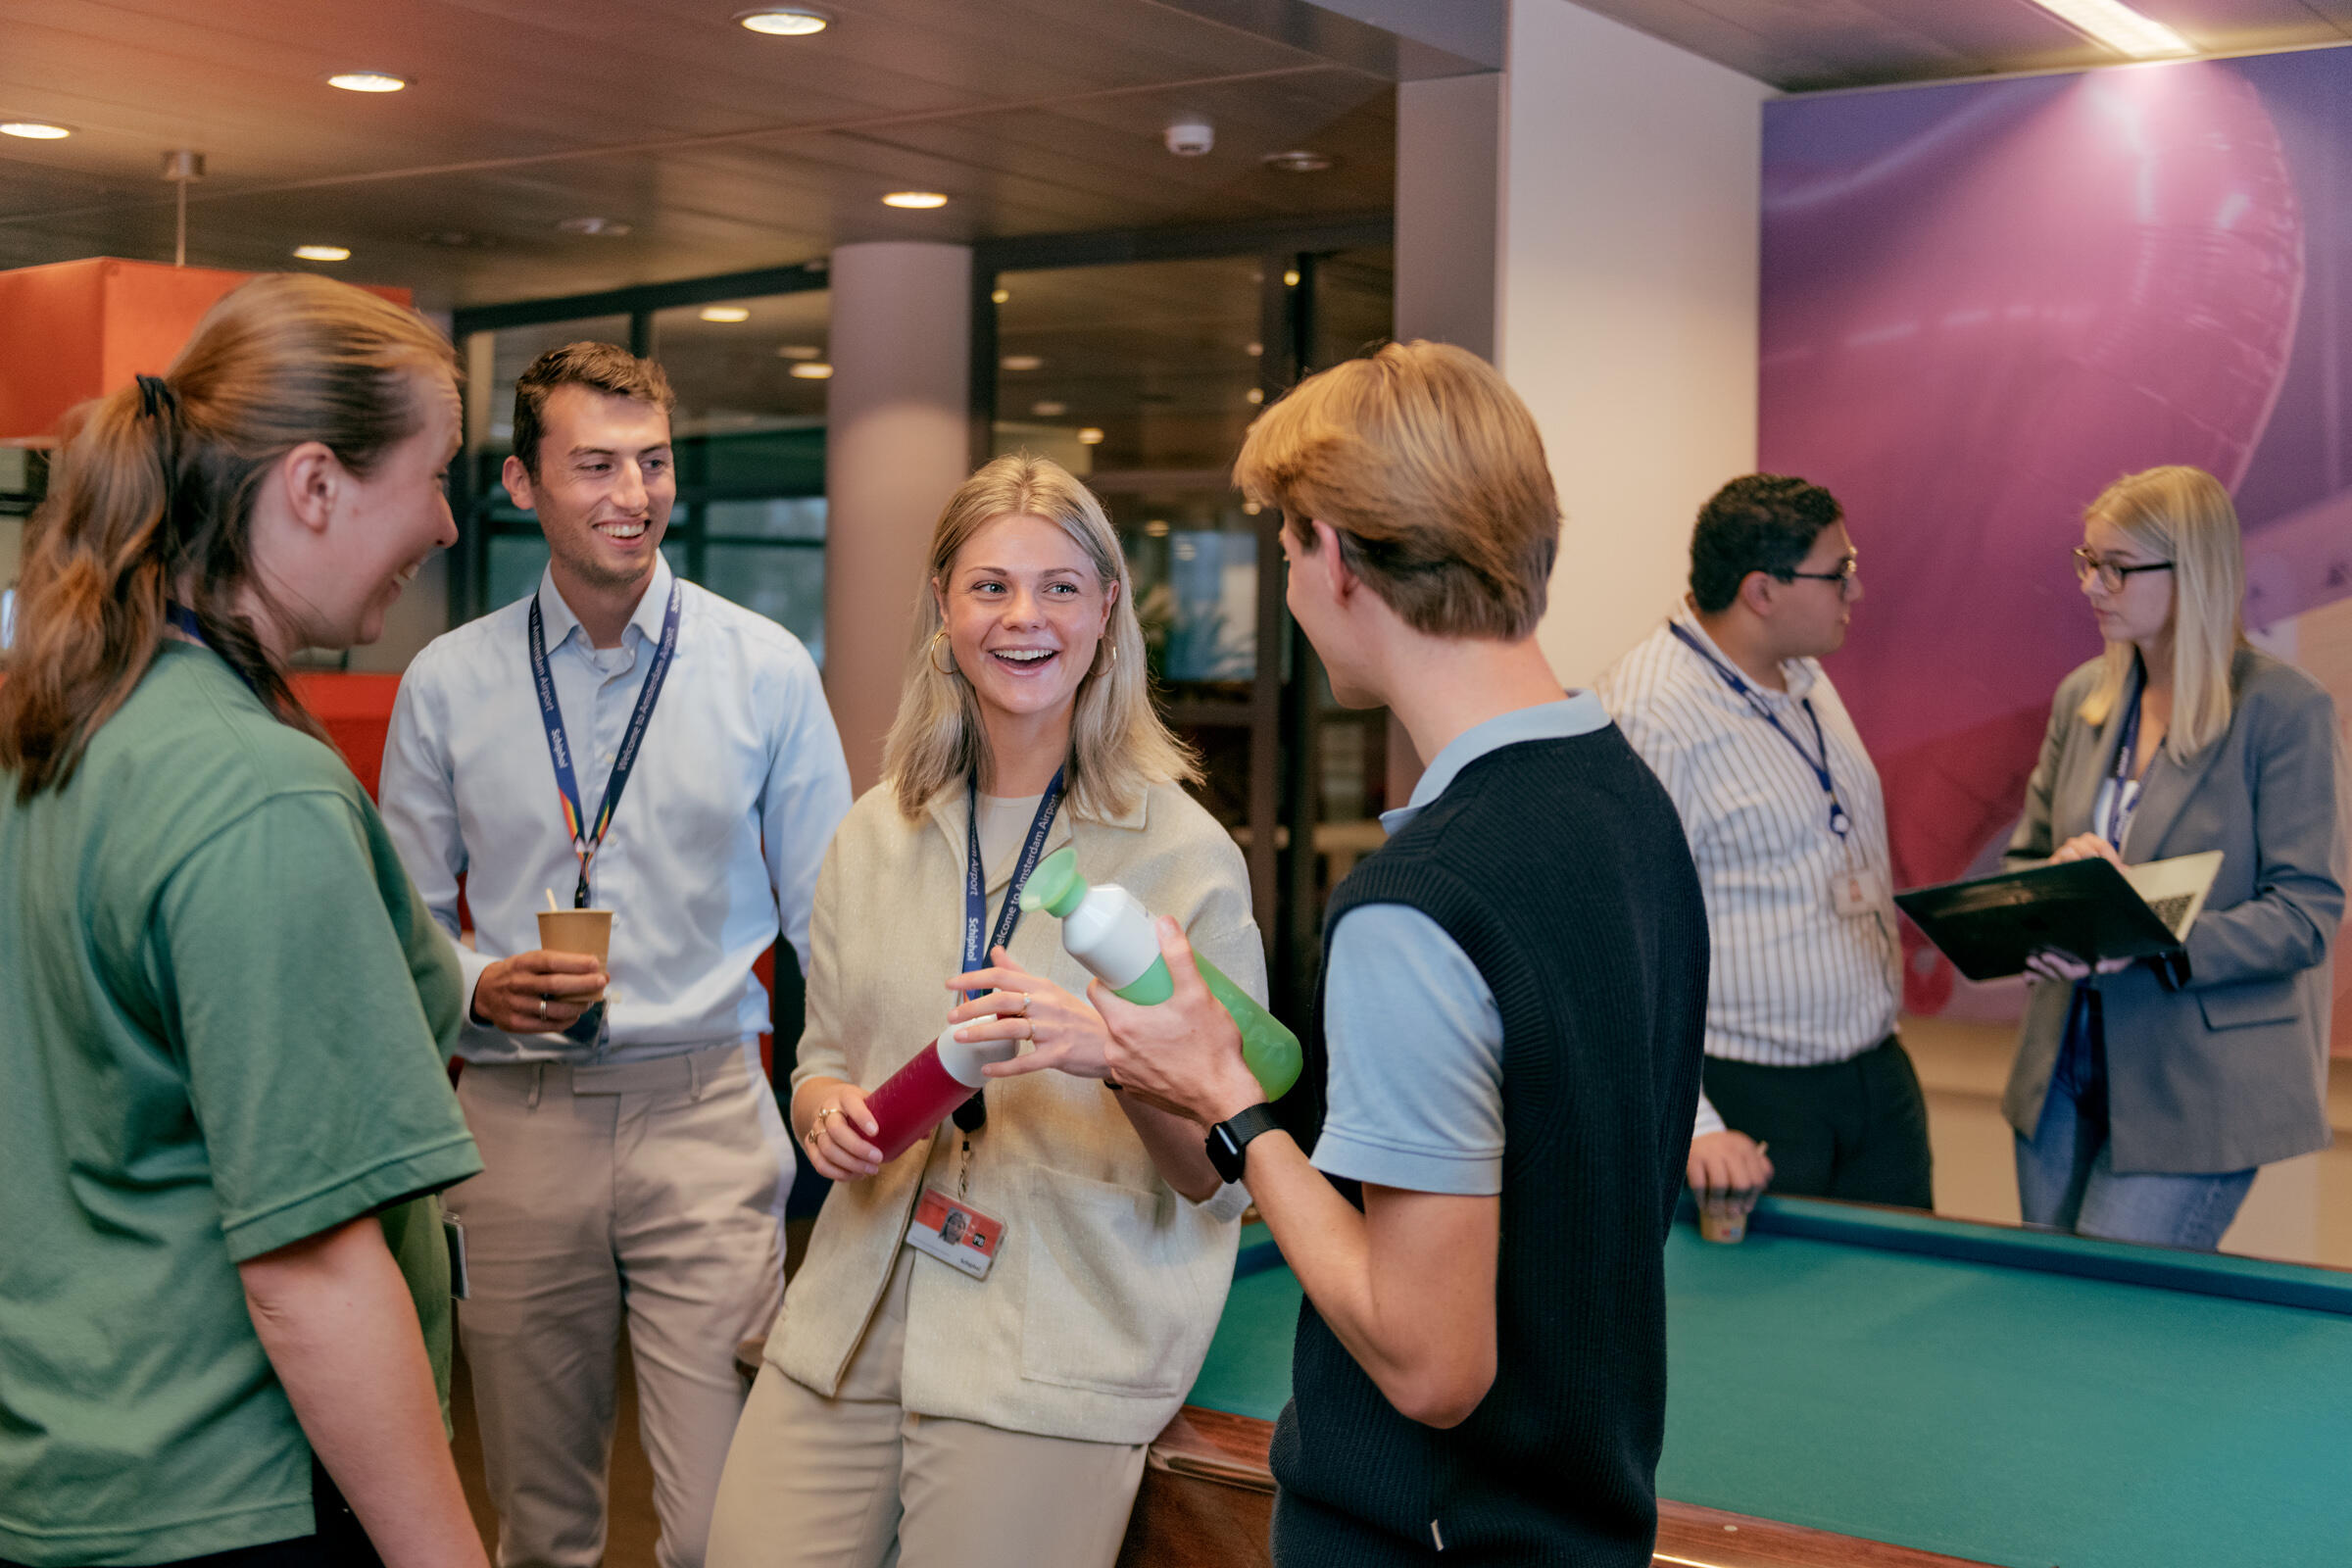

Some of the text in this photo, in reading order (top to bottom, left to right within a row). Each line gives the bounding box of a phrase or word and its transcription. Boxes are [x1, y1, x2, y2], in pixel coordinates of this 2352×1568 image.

[540, 676, 555, 712] Airport
[639, 660, 666, 713] Amsterdam
[551, 728, 568, 768] Schiphol
[968, 857, 979, 896] Airport
[994, 794, 1059, 948] elcome to Amsterdam Airport
[966, 916, 979, 961] Schiphol
